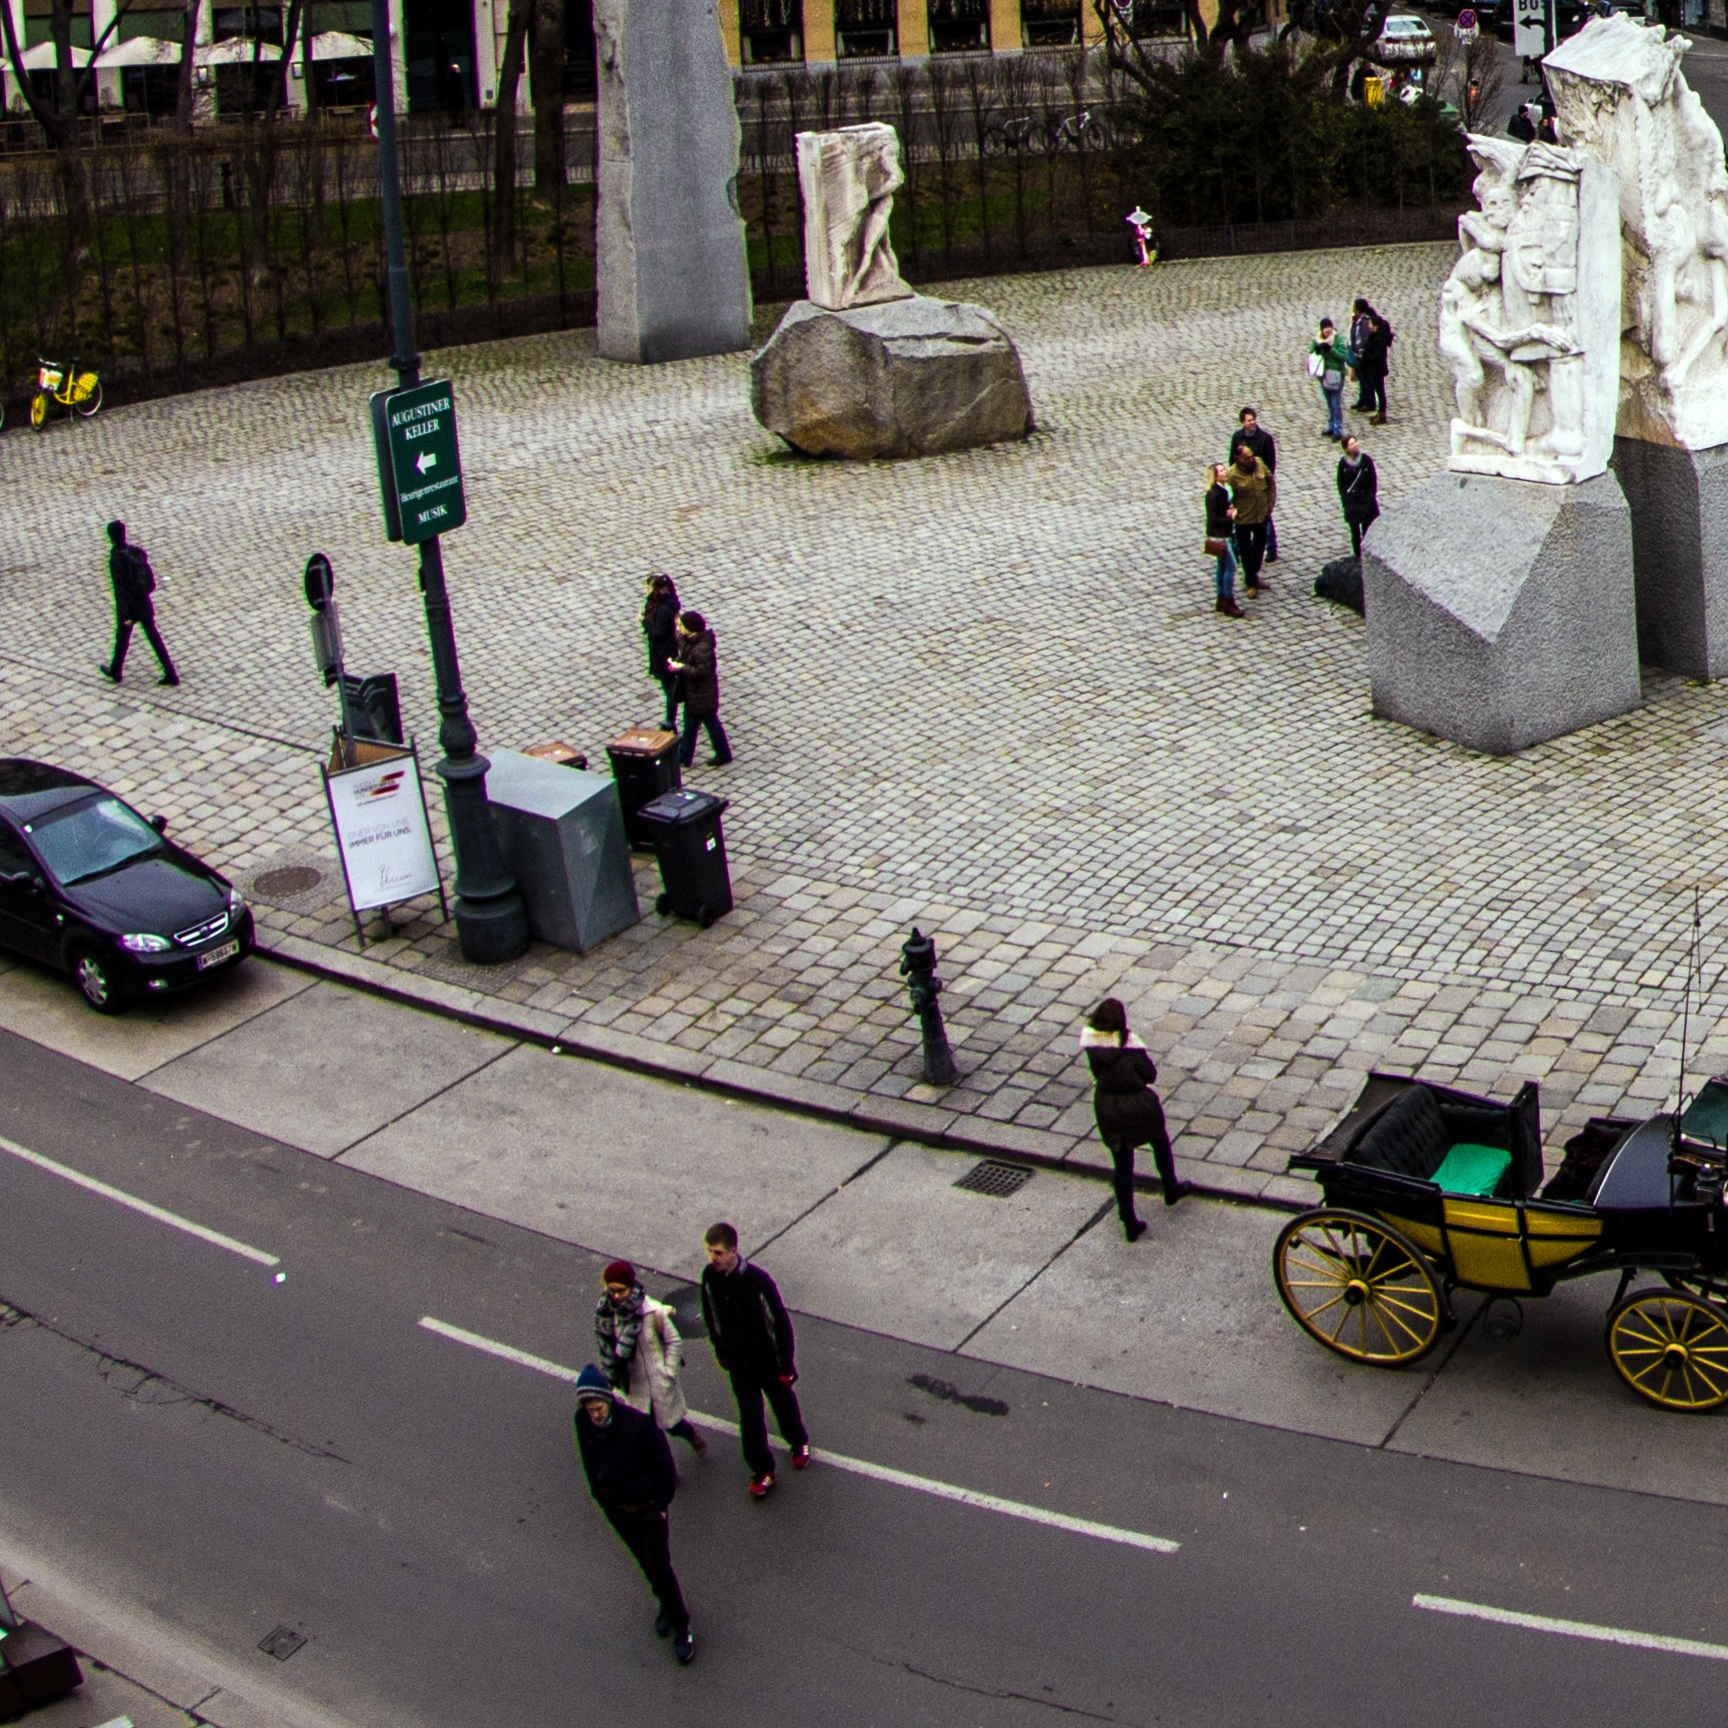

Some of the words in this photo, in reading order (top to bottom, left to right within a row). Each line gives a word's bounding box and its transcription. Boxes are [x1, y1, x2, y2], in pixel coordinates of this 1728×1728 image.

[391, 397, 450, 427] AUGUSTINER
[404, 419, 440, 441] KELLER
[418, 504, 448, 524] MUSIK
[350, 835, 375, 850] IMMER
[376, 831, 392, 842] FÜR
